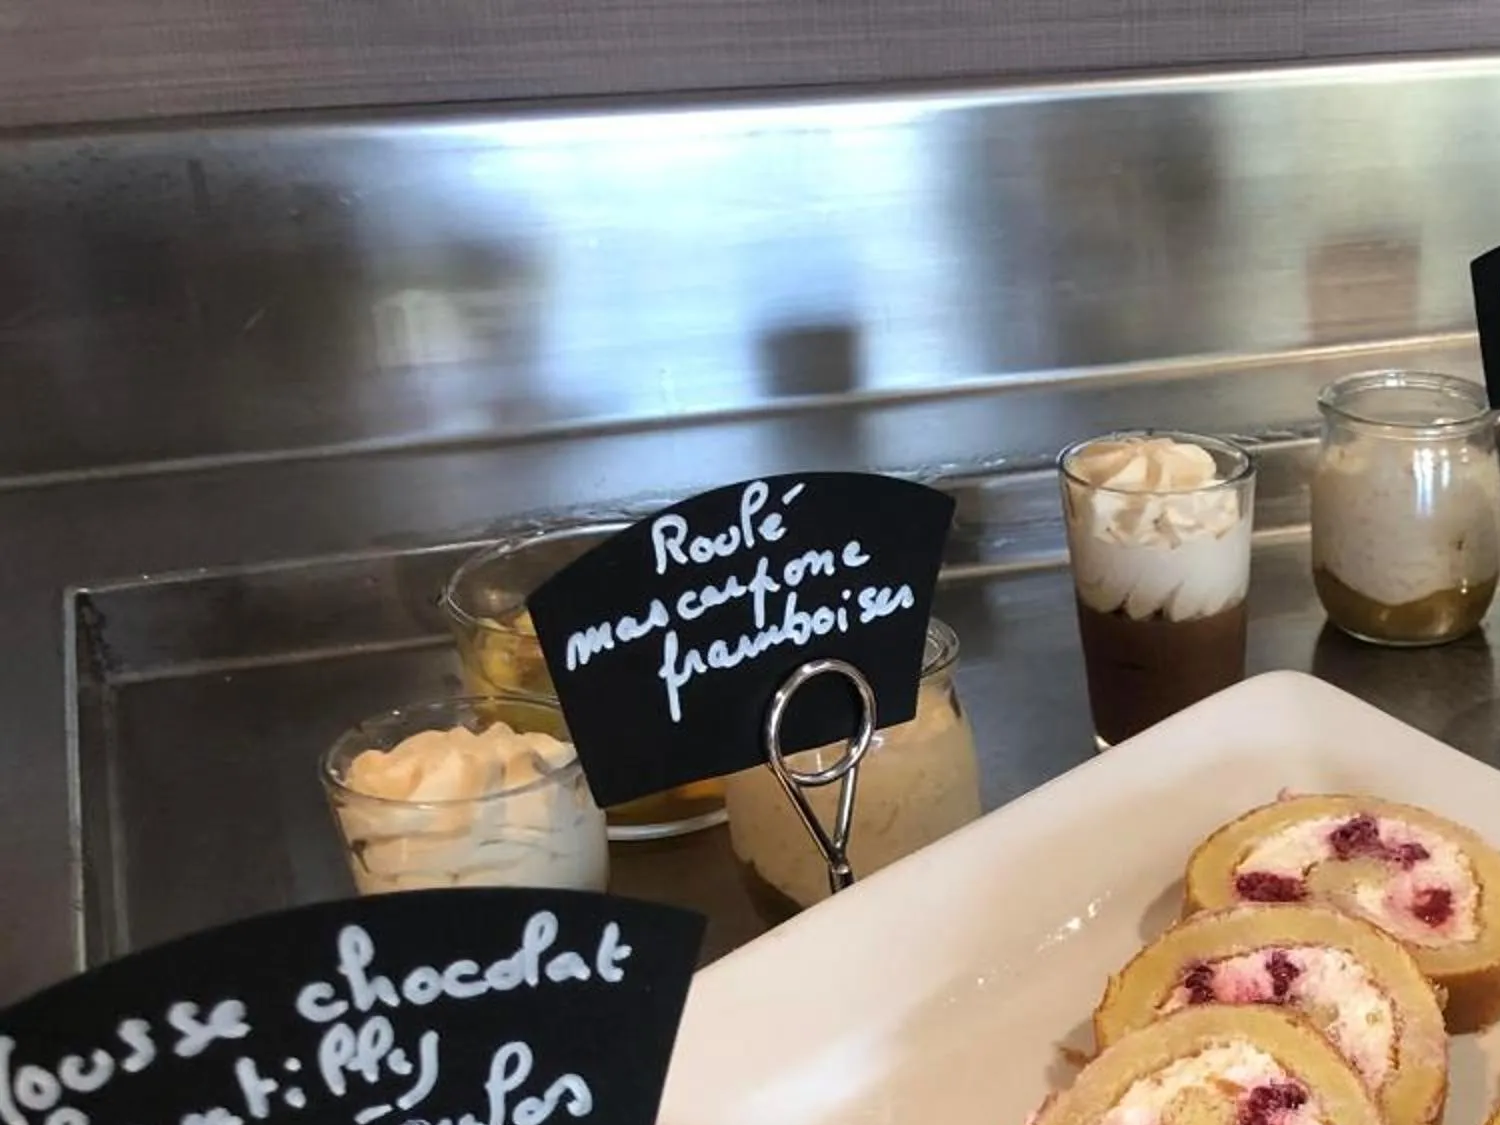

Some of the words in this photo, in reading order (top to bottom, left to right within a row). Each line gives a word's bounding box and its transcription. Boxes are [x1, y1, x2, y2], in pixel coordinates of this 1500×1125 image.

[652, 481, 805, 574] Roulé
[566, 541, 871, 671] mascarpone
[659, 584, 915, 722] framboises
[297, 911, 633, 1022] chocolat
